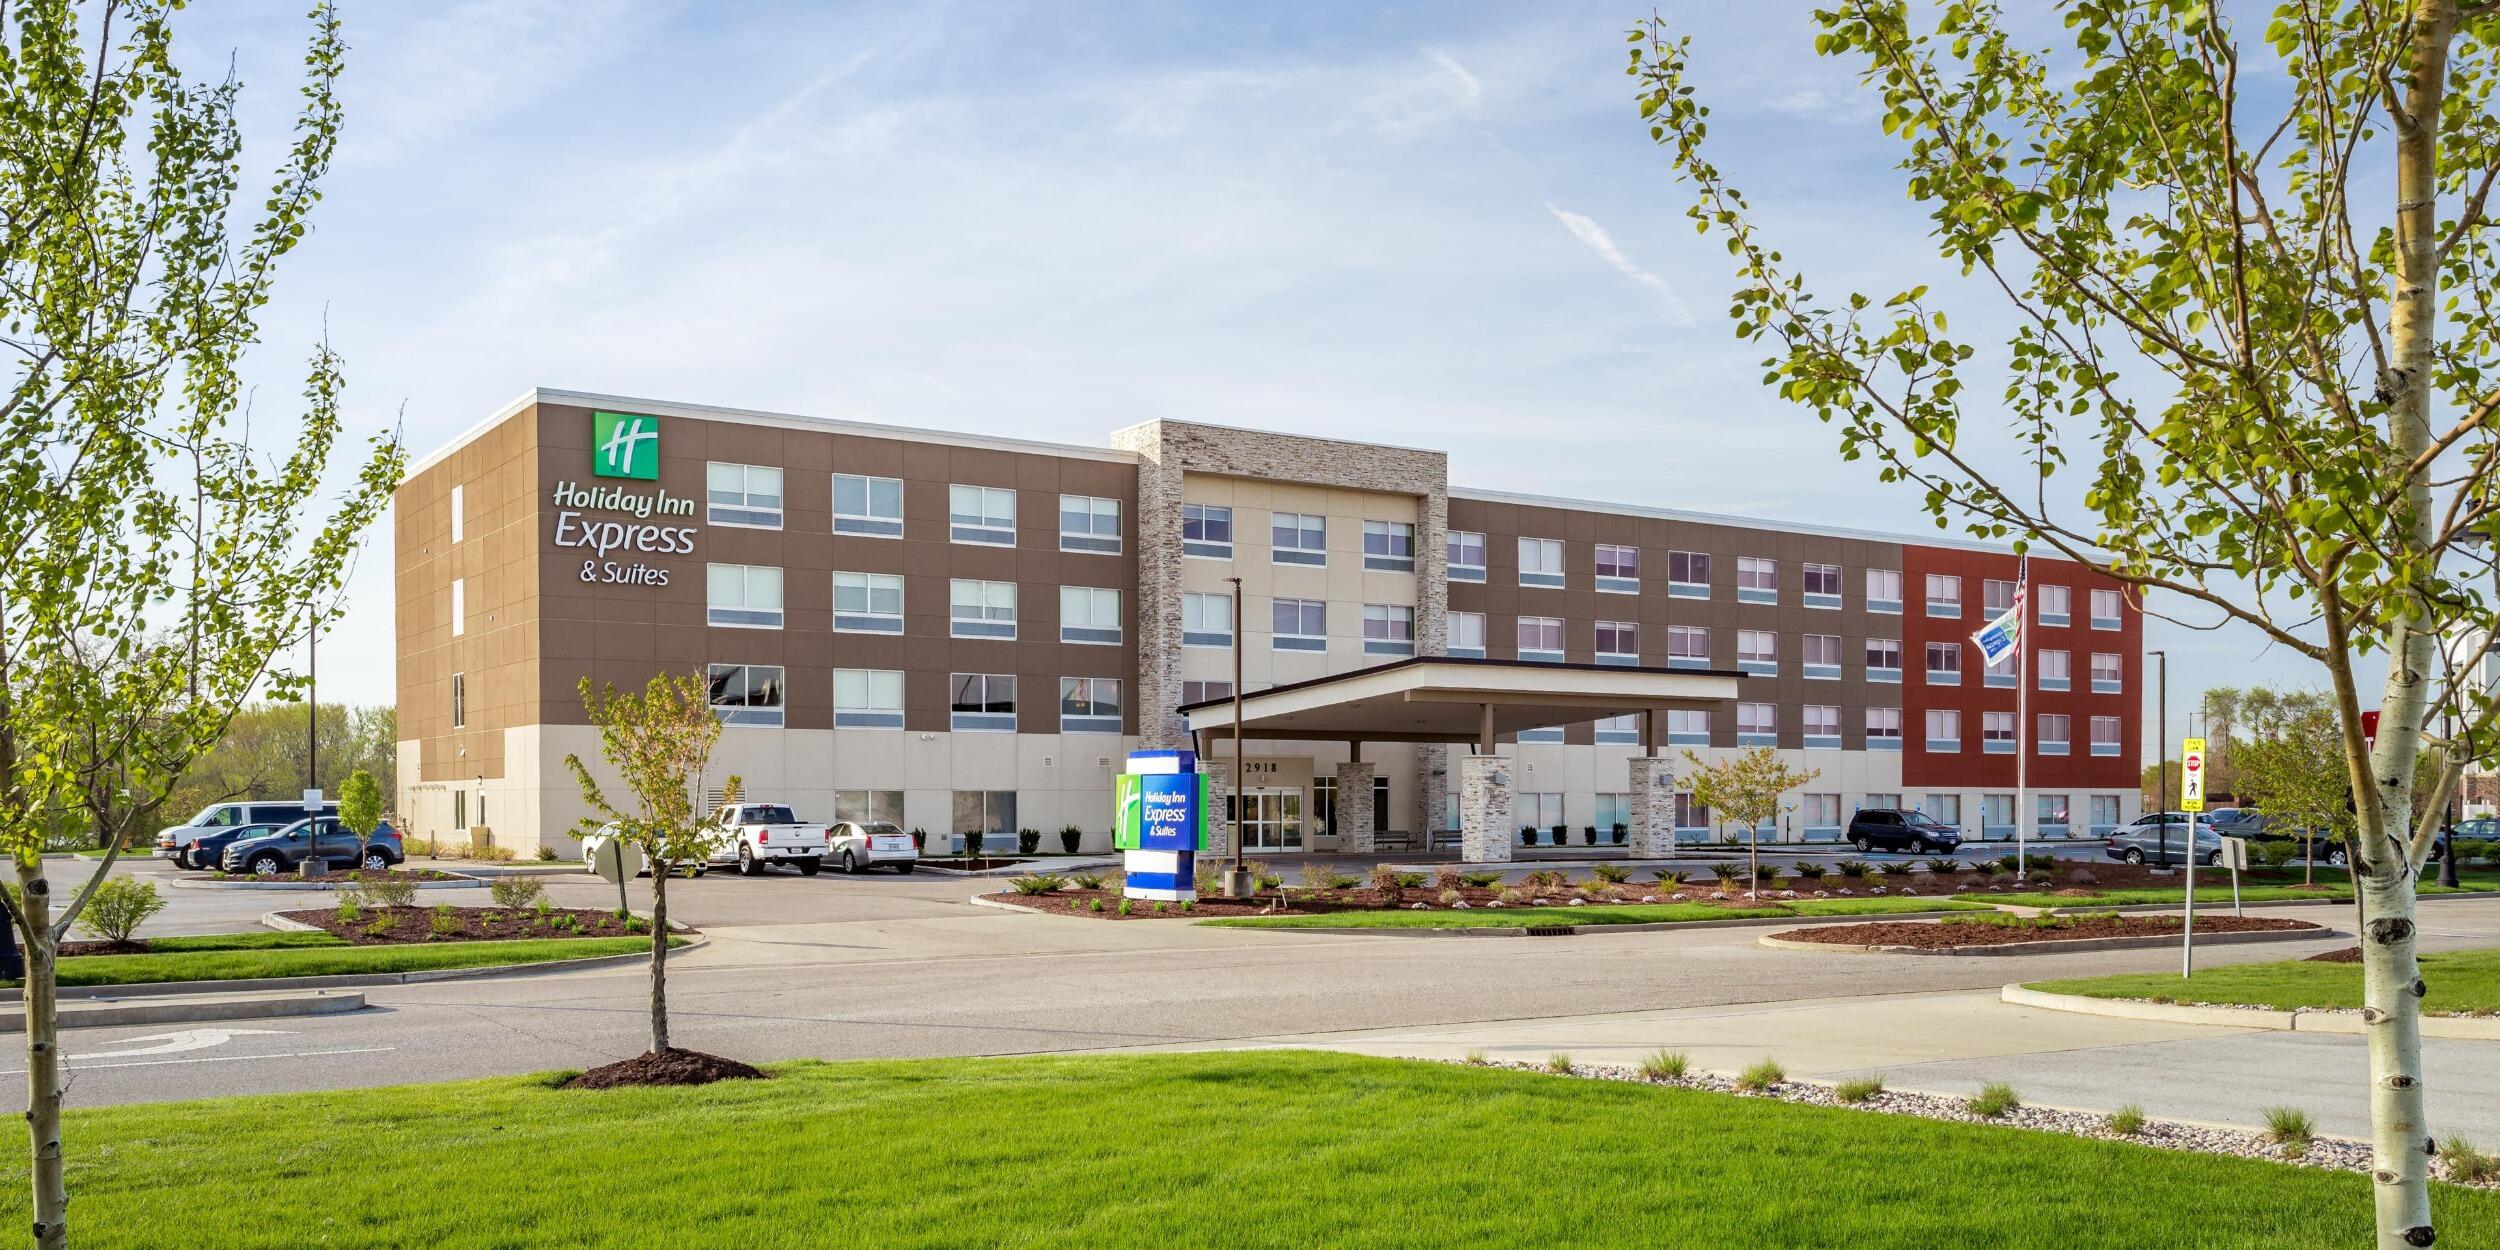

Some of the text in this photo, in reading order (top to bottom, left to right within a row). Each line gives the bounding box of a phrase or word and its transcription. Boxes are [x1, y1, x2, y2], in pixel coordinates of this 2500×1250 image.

[553, 480, 695, 519] Holiday Inn
[554, 511, 697, 558] Express
[580, 560, 670, 586] & Suites
[1245, 762, 1277, 773] 2918
[1145, 791, 1186, 806] Holiday Inn
[1144, 805, 1187, 825] Express
[1150, 825, 1177, 837] & Suites
